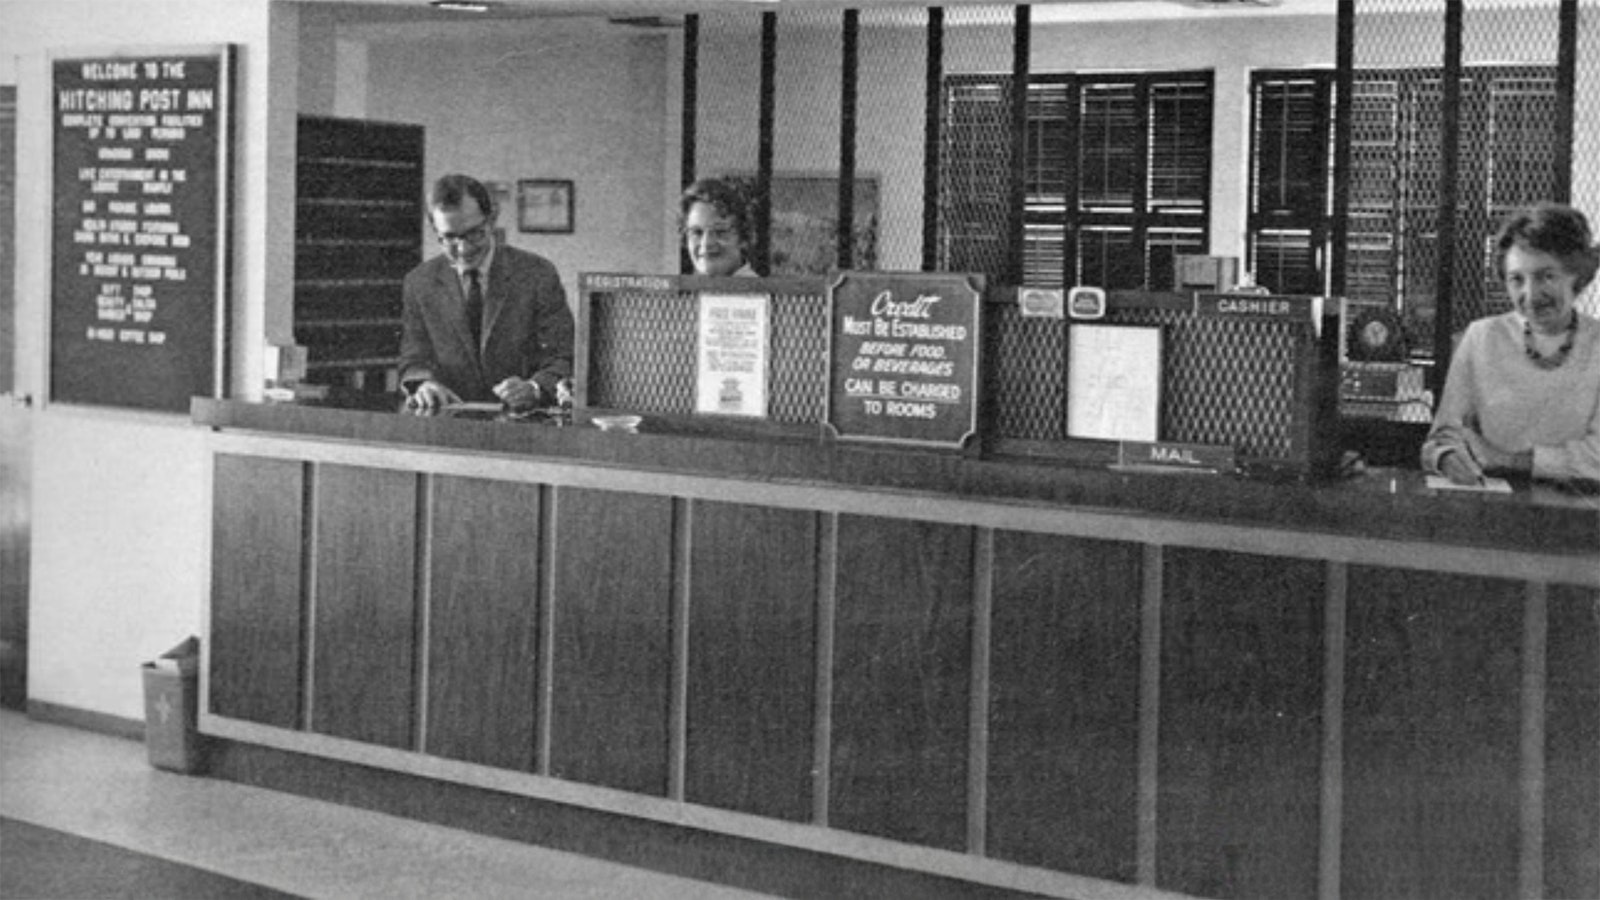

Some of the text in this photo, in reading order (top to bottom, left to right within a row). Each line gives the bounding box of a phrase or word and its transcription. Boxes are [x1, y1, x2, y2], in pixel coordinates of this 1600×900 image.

[82, 61, 185, 80] WELCOME TO THE
[59, 88, 213, 111] HITCHING POST INN
[870, 290, 942, 319] Credit
[1218, 298, 1290, 315] CASHIER
[843, 315, 967, 341] MUST BE ESTABLISHED
[859, 341, 908, 357] BEFORE
[852, 356, 955, 377] OR BEVERAGES
[844, 377, 962, 400] CAN BE CHARGED
[864, 400, 937, 419] TO ROOMS
[1151, 447, 1201, 464] MAIL
